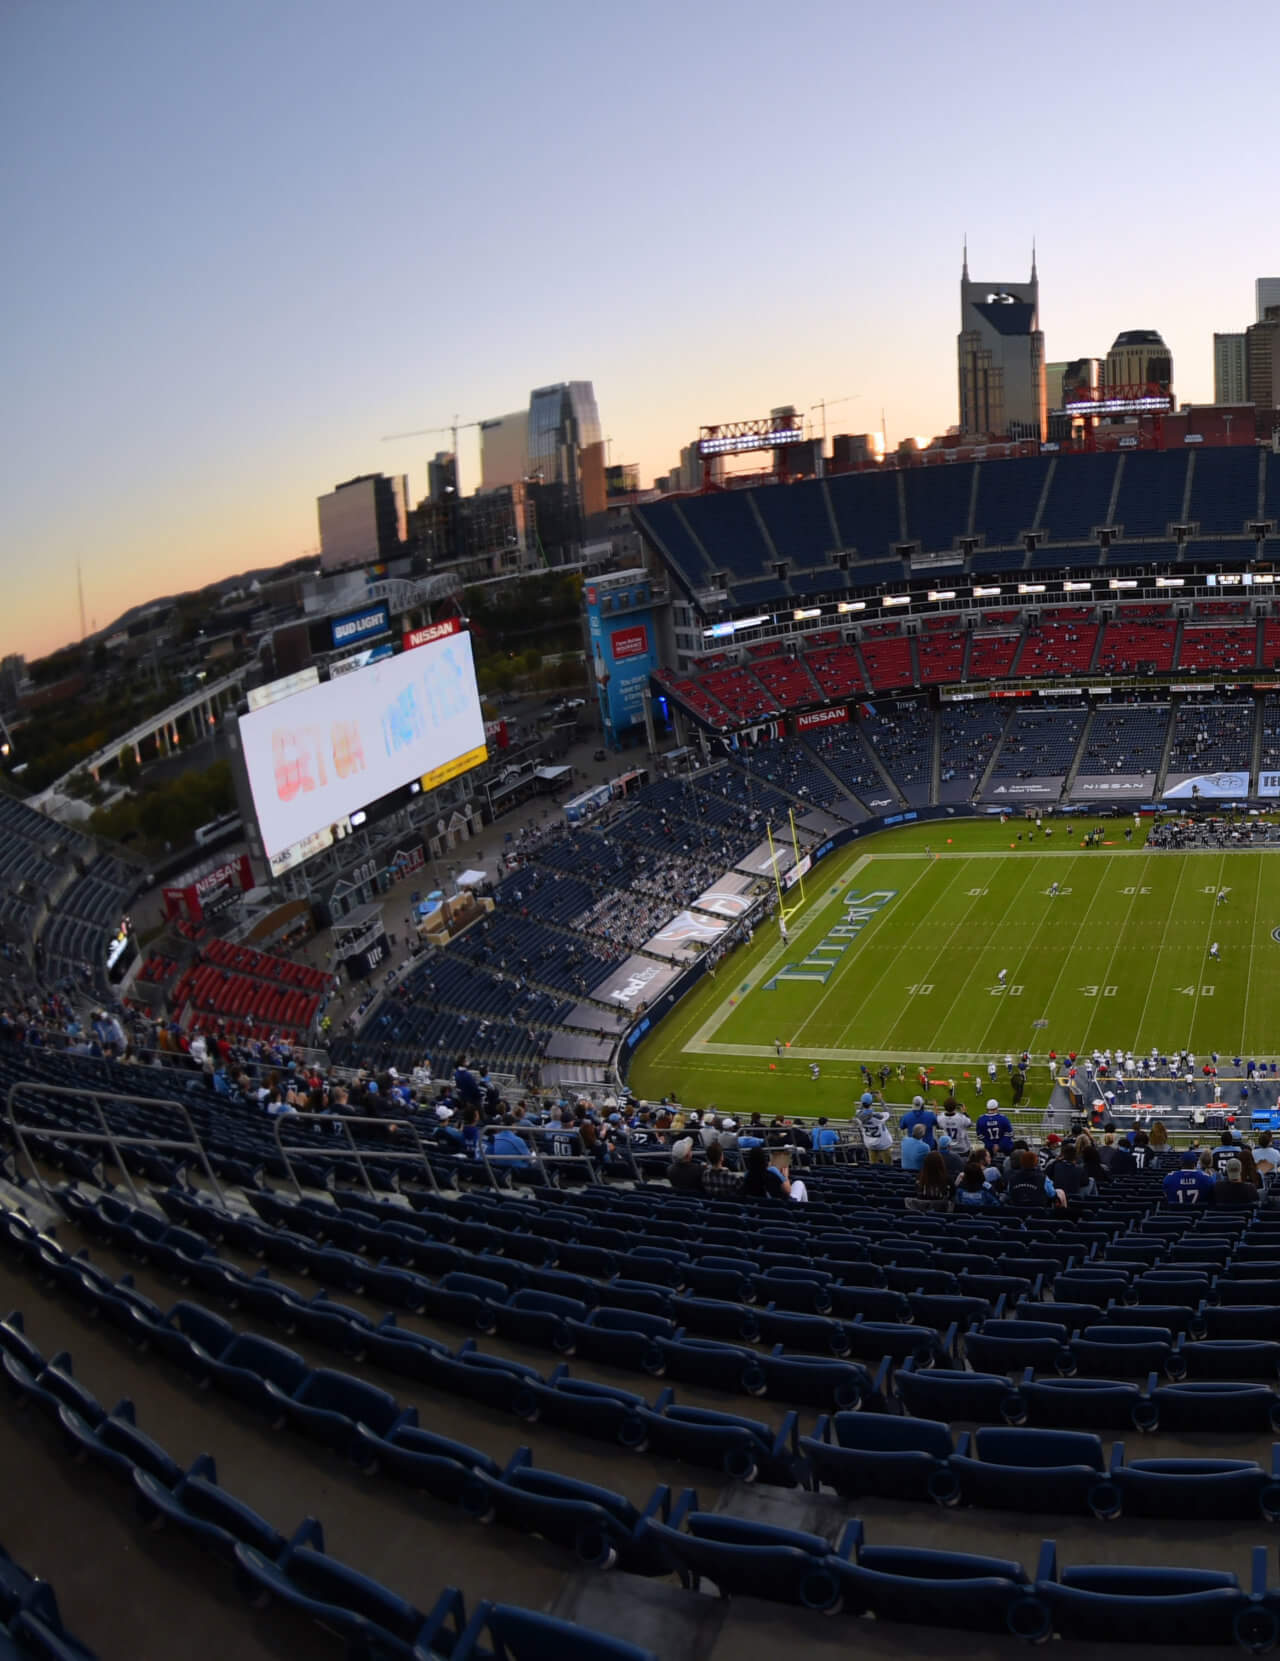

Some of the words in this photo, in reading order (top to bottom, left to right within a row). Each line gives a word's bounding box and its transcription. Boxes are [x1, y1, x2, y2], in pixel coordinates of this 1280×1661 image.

[335, 621, 357, 639] BUD
[356, 612, 384, 632] LIGHT
[410, 621, 453, 647] NISSAN
[799, 709, 846, 726] NISSAN
[196, 860, 241, 894] NISSAN
[761, 889, 898, 990] TITANS
[913, 984, 935, 995] 10
[989, 985, 1024, 996] 20
[1084, 985, 1118, 997] 30
[1180, 985, 1216, 997] 40
[987, 1128, 999, 1140] 17
[1176, 1189, 1200, 1204] 17
